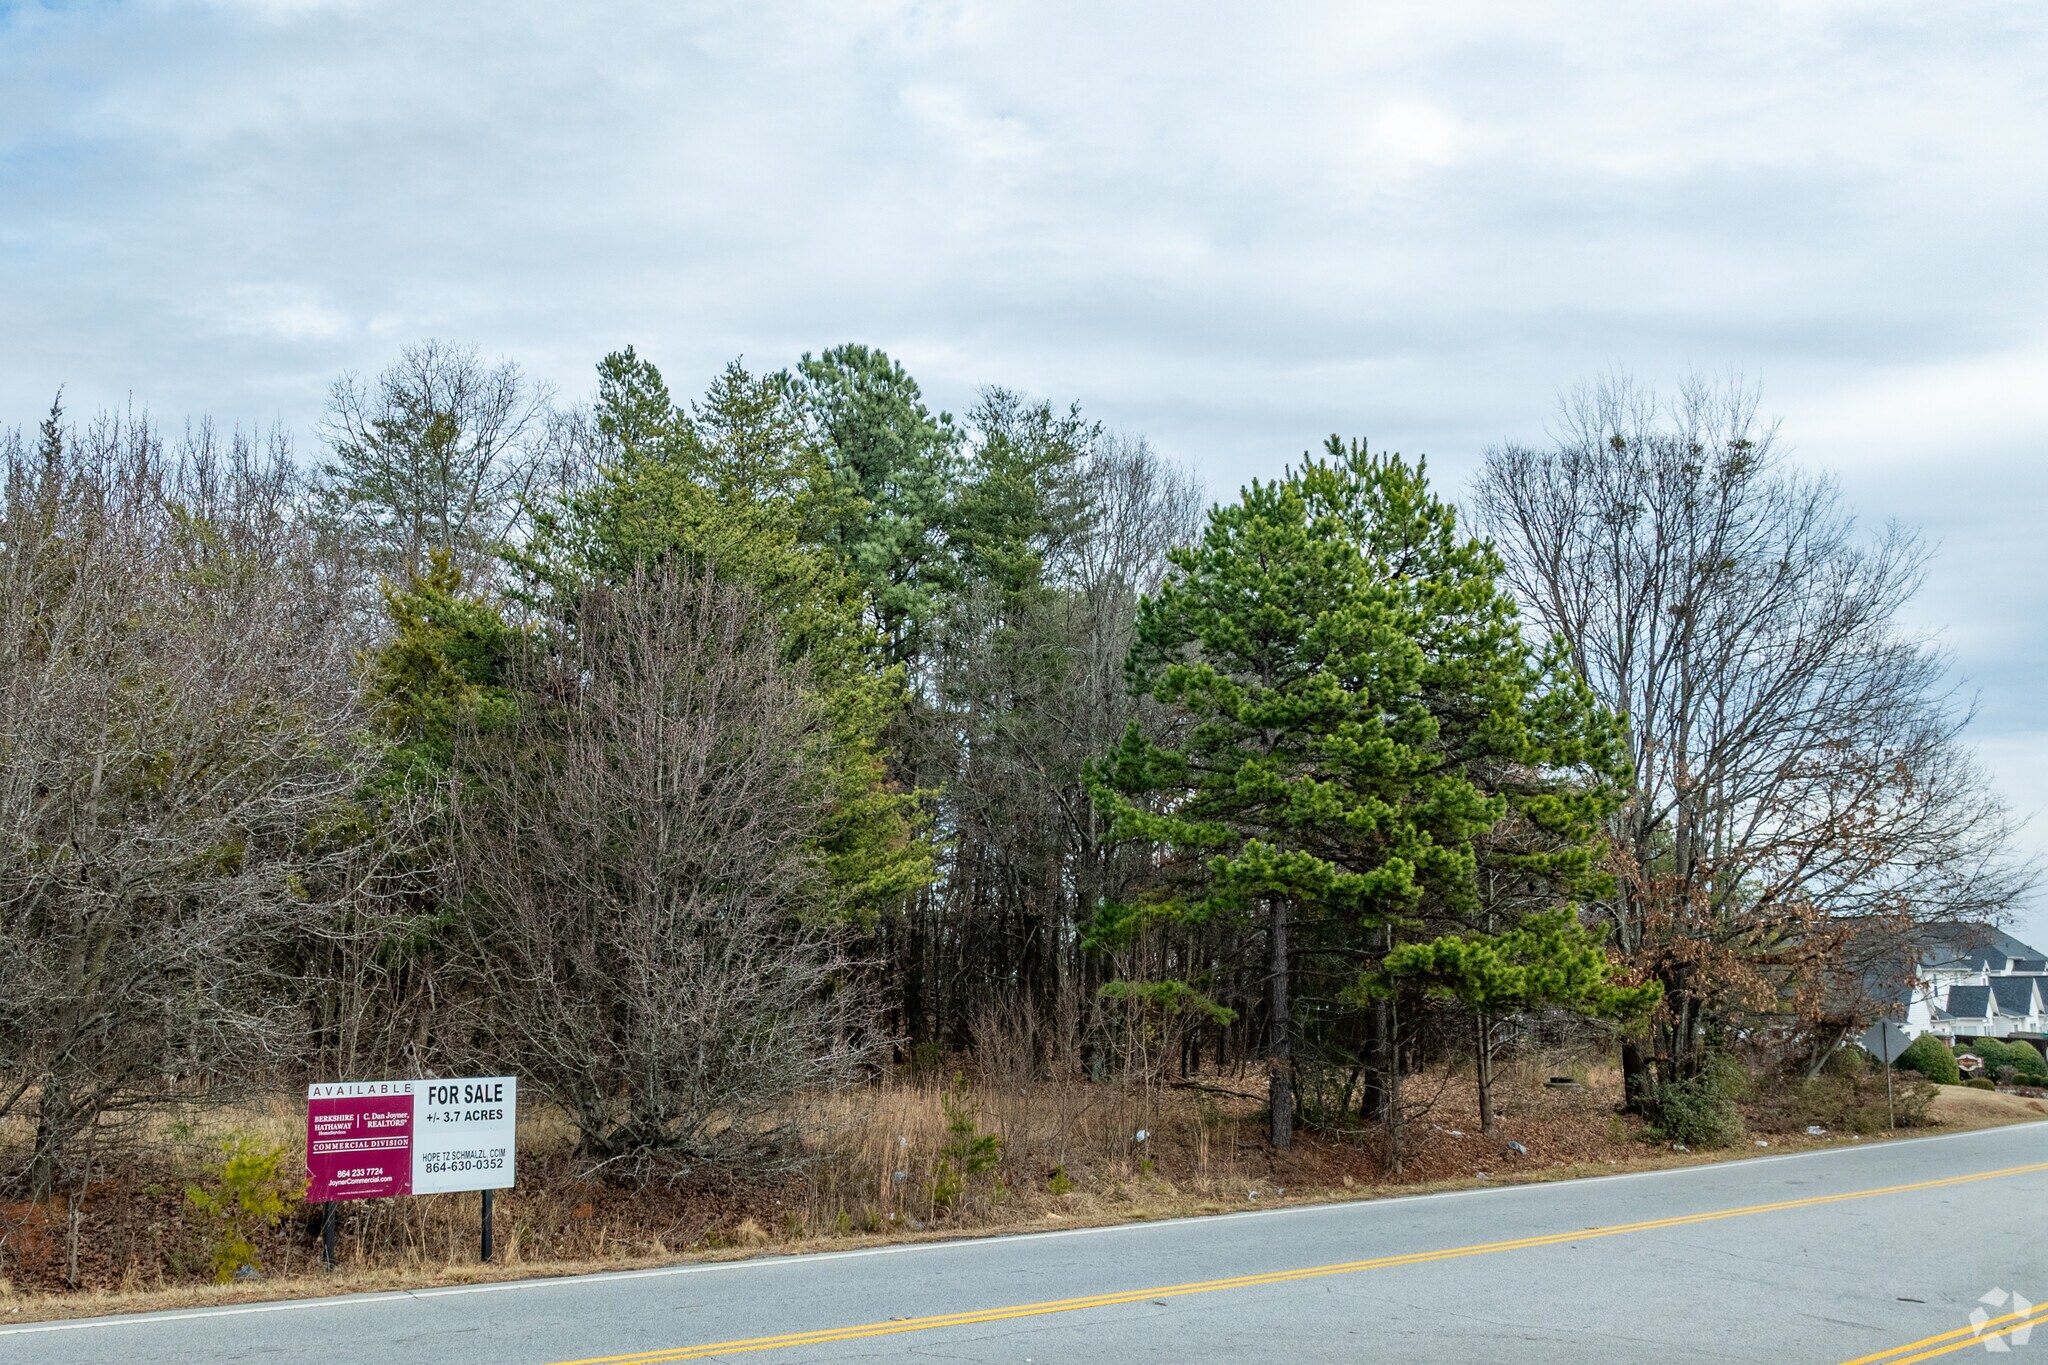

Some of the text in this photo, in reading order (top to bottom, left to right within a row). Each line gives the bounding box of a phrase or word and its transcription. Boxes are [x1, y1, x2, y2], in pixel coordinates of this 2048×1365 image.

[313, 1084, 411, 1096] AVAILABLE
[429, 1084, 502, 1105] FOR SALE
[315, 1114, 354, 1122] BERKSHIRE
[427, 1109, 503, 1123] +/- 3.7 ACRES
[315, 1123, 352, 1131] HATHAWAY
[313, 1139, 408, 1151] COMMERCIAL DIVISION
[423, 1152, 440, 1162] HOPE
[443, 1152, 450, 1160] TZ
[490, 1149, 505, 1157] CCIM
[426, 1159, 503, 1173] 864-630-0352
[337, 1170, 350, 1178] 864
[352, 1169, 365, 1177] 233
[329, 1176, 392, 1186] JoynerCommercial.com
